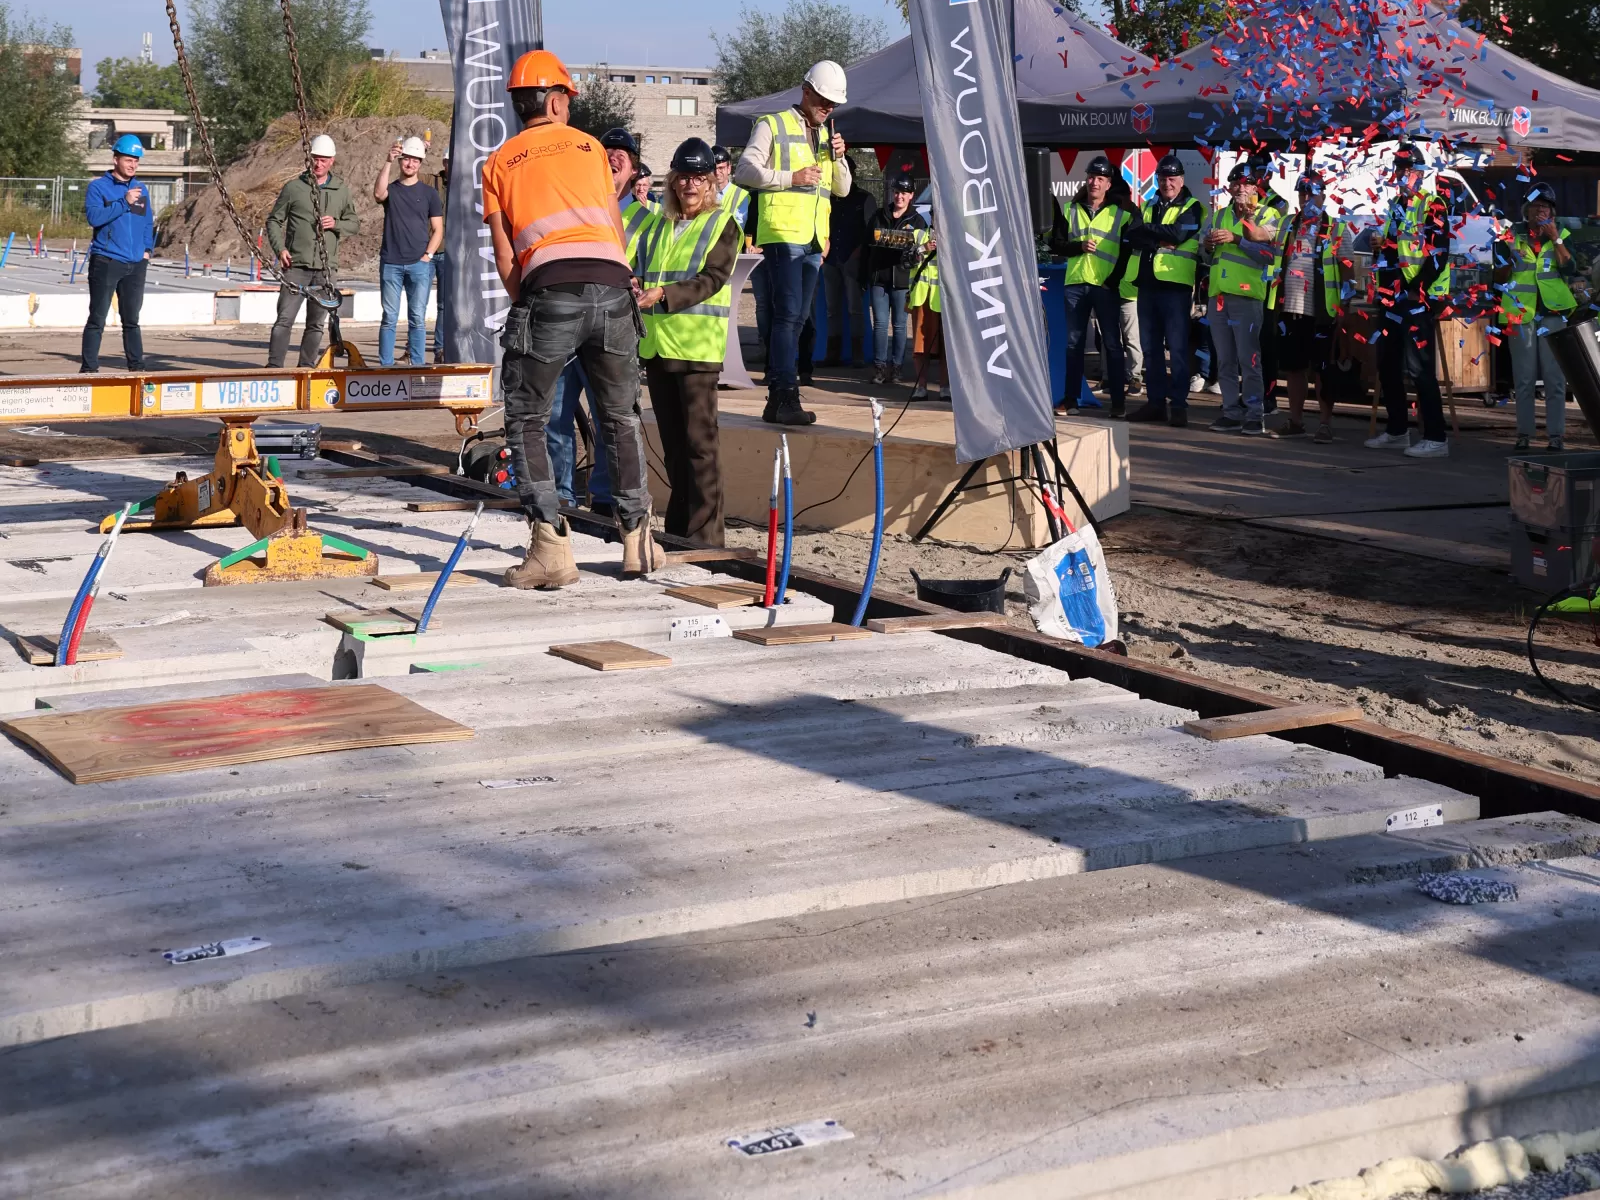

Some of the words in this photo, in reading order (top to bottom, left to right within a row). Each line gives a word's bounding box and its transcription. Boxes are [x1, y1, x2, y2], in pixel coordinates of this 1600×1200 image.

[1060, 113, 1088, 126] VINK
[1090, 112, 1127, 126] BOUW
[1450, 108, 1479, 124] VINK
[506, 149, 528, 168] SDV
[530, 141, 573, 155] GROEP
[1052, 181, 1079, 197] VINK
[218, 380, 279, 404] VBI-035
[347, 380, 391, 397] Code
[395, 379, 408, 396] A
[25, 396, 54, 405] gewicht
[79, 394, 88, 403] kg
[683, 629, 702, 638] 314T
[1405, 811, 1418, 822] 112
[748, 1135, 793, 1153] 314T
